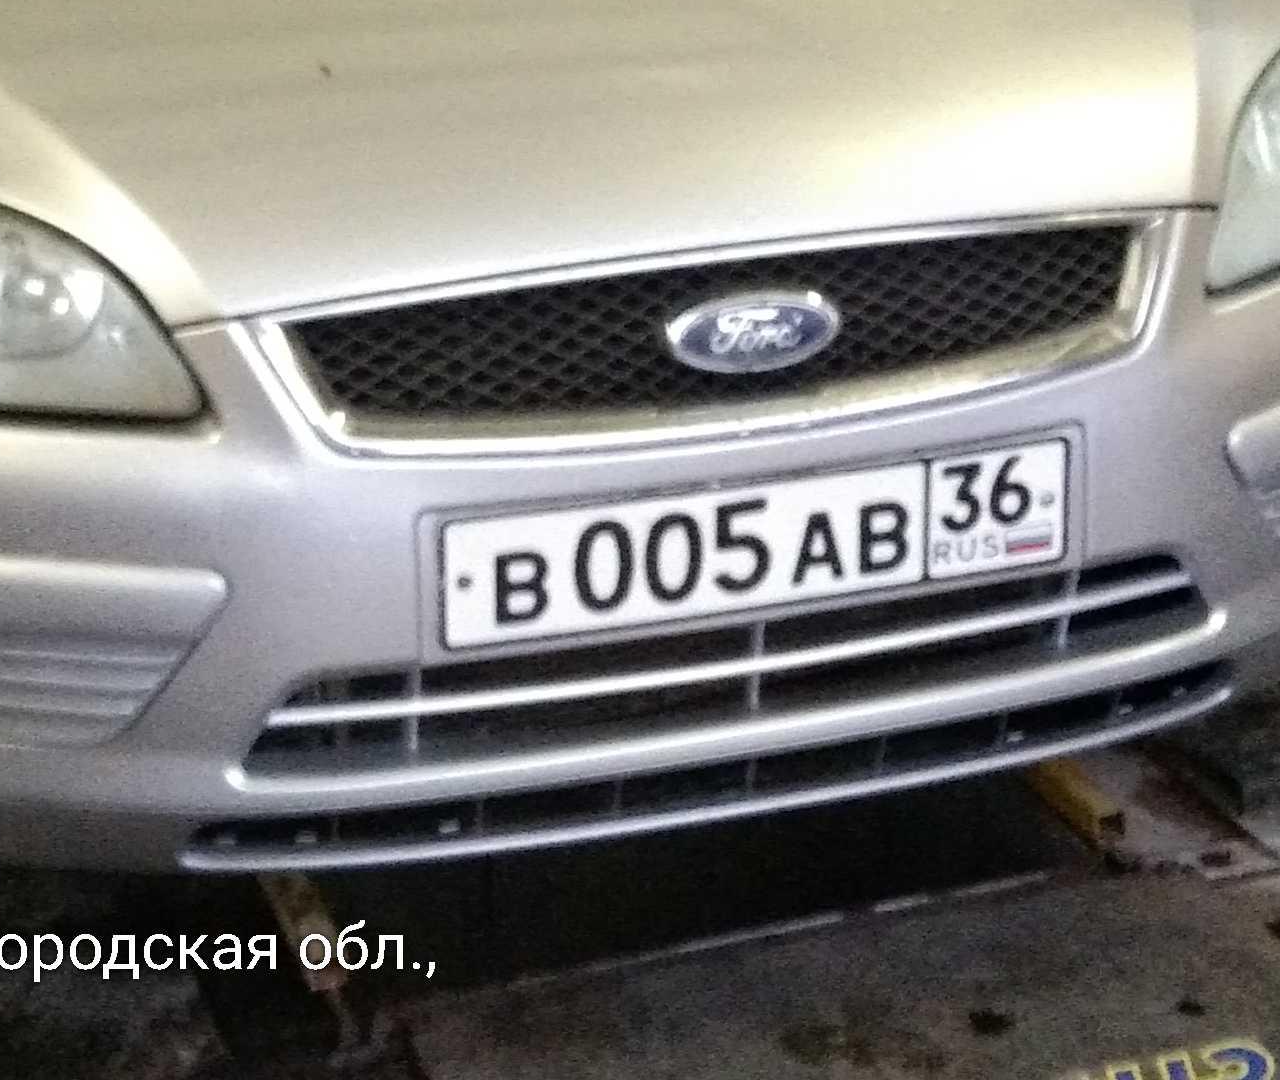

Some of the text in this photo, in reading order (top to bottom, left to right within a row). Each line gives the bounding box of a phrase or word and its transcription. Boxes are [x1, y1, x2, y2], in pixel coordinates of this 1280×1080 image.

[708, 306, 803, 355] Ford
[940, 455, 1032, 532] 36
[932, 534, 1001, 565] RUS
